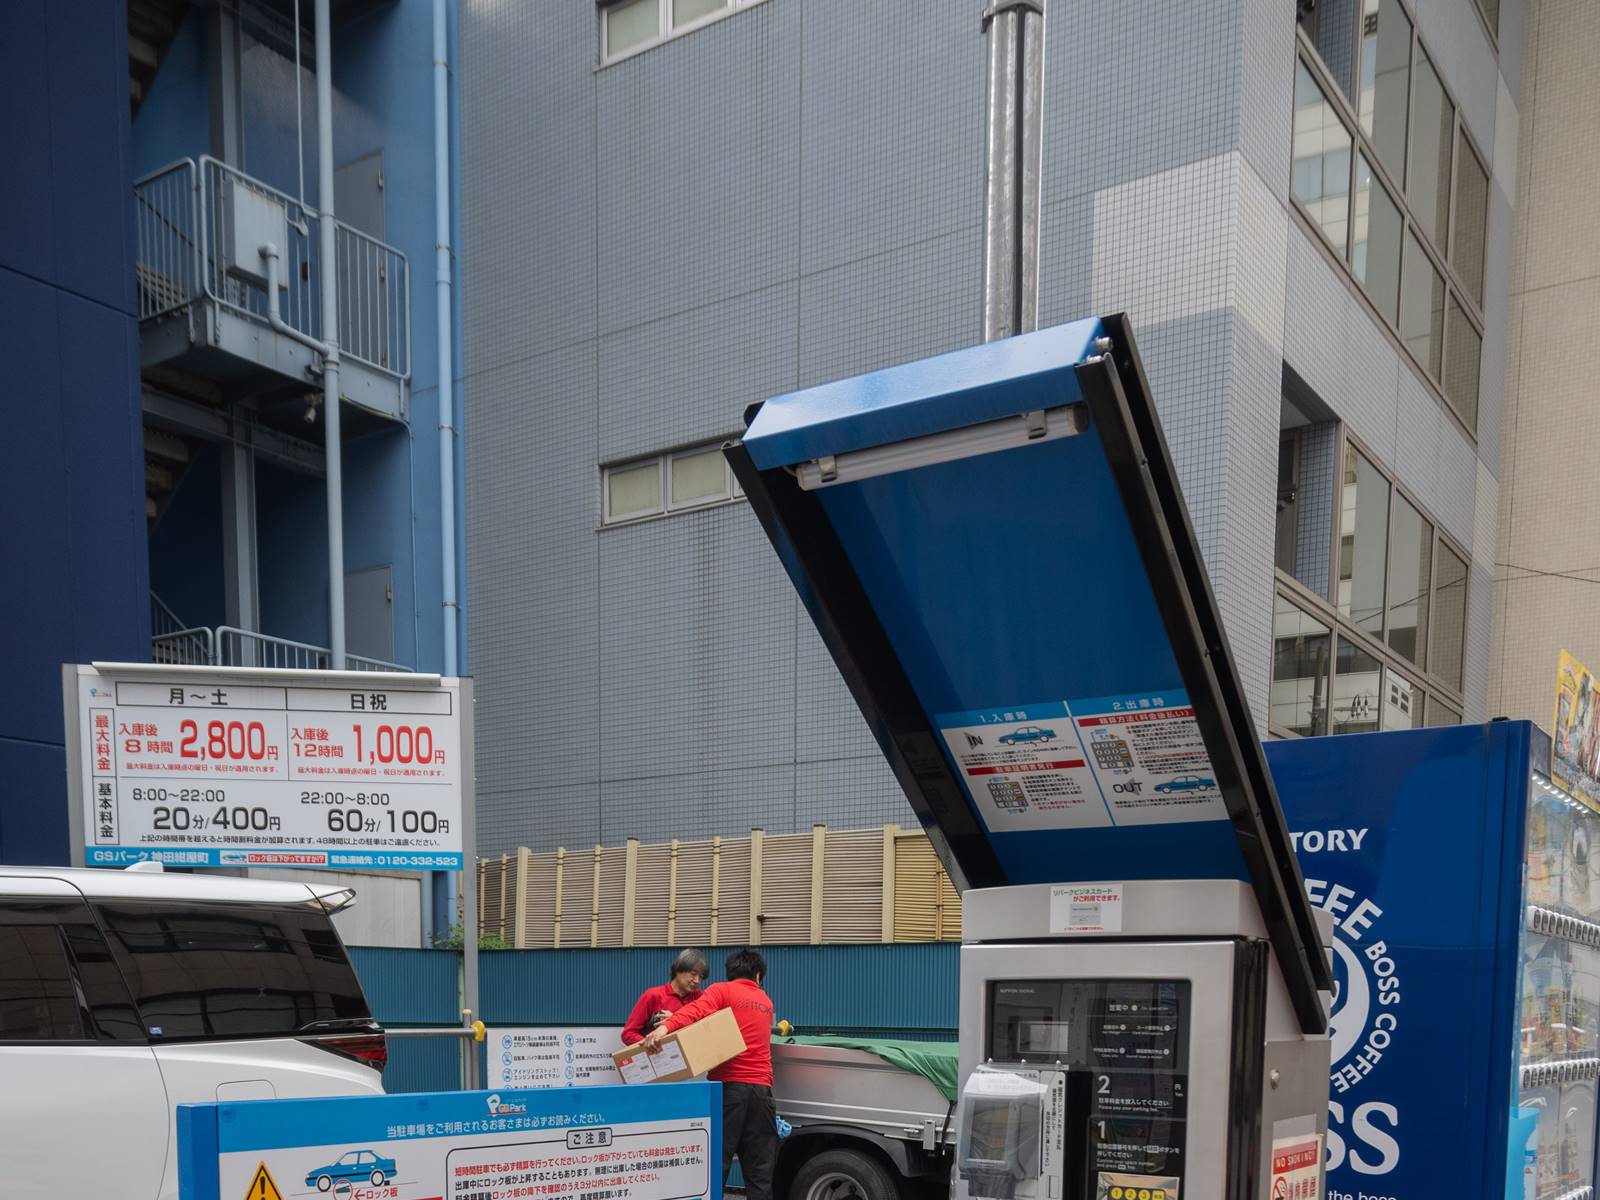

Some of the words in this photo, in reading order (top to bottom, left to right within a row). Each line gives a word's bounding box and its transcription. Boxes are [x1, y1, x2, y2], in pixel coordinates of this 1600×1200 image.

[119, 723, 157, 737] 入庫後
[290, 728, 329, 741] 入庫後
[95, 715, 111, 770] 最大料金
[147, 741, 174, 753] 時間
[179, 719, 279, 761] 2,800円
[353, 724, 446, 765] 1,000円
[967, 735, 983, 747] IN
[293, 743, 343, 758] 12時間
[1112, 782, 1142, 793] OUT
[98, 783, 114, 838] 基本料金
[1053, 888, 1112, 896] リパークビジネスカード
[1364, 940, 1400, 1005] BOSS
[1329, 1013, 1397, 1093] COFFEE
[1098, 1075, 1110, 1094] 2
[1097, 1121, 1105, 1139] 1
[572, 1131, 607, 1146] ご注意
[1276, 1159, 1286, 1168] NO
[365, 1187, 397, 1200] ロック板
